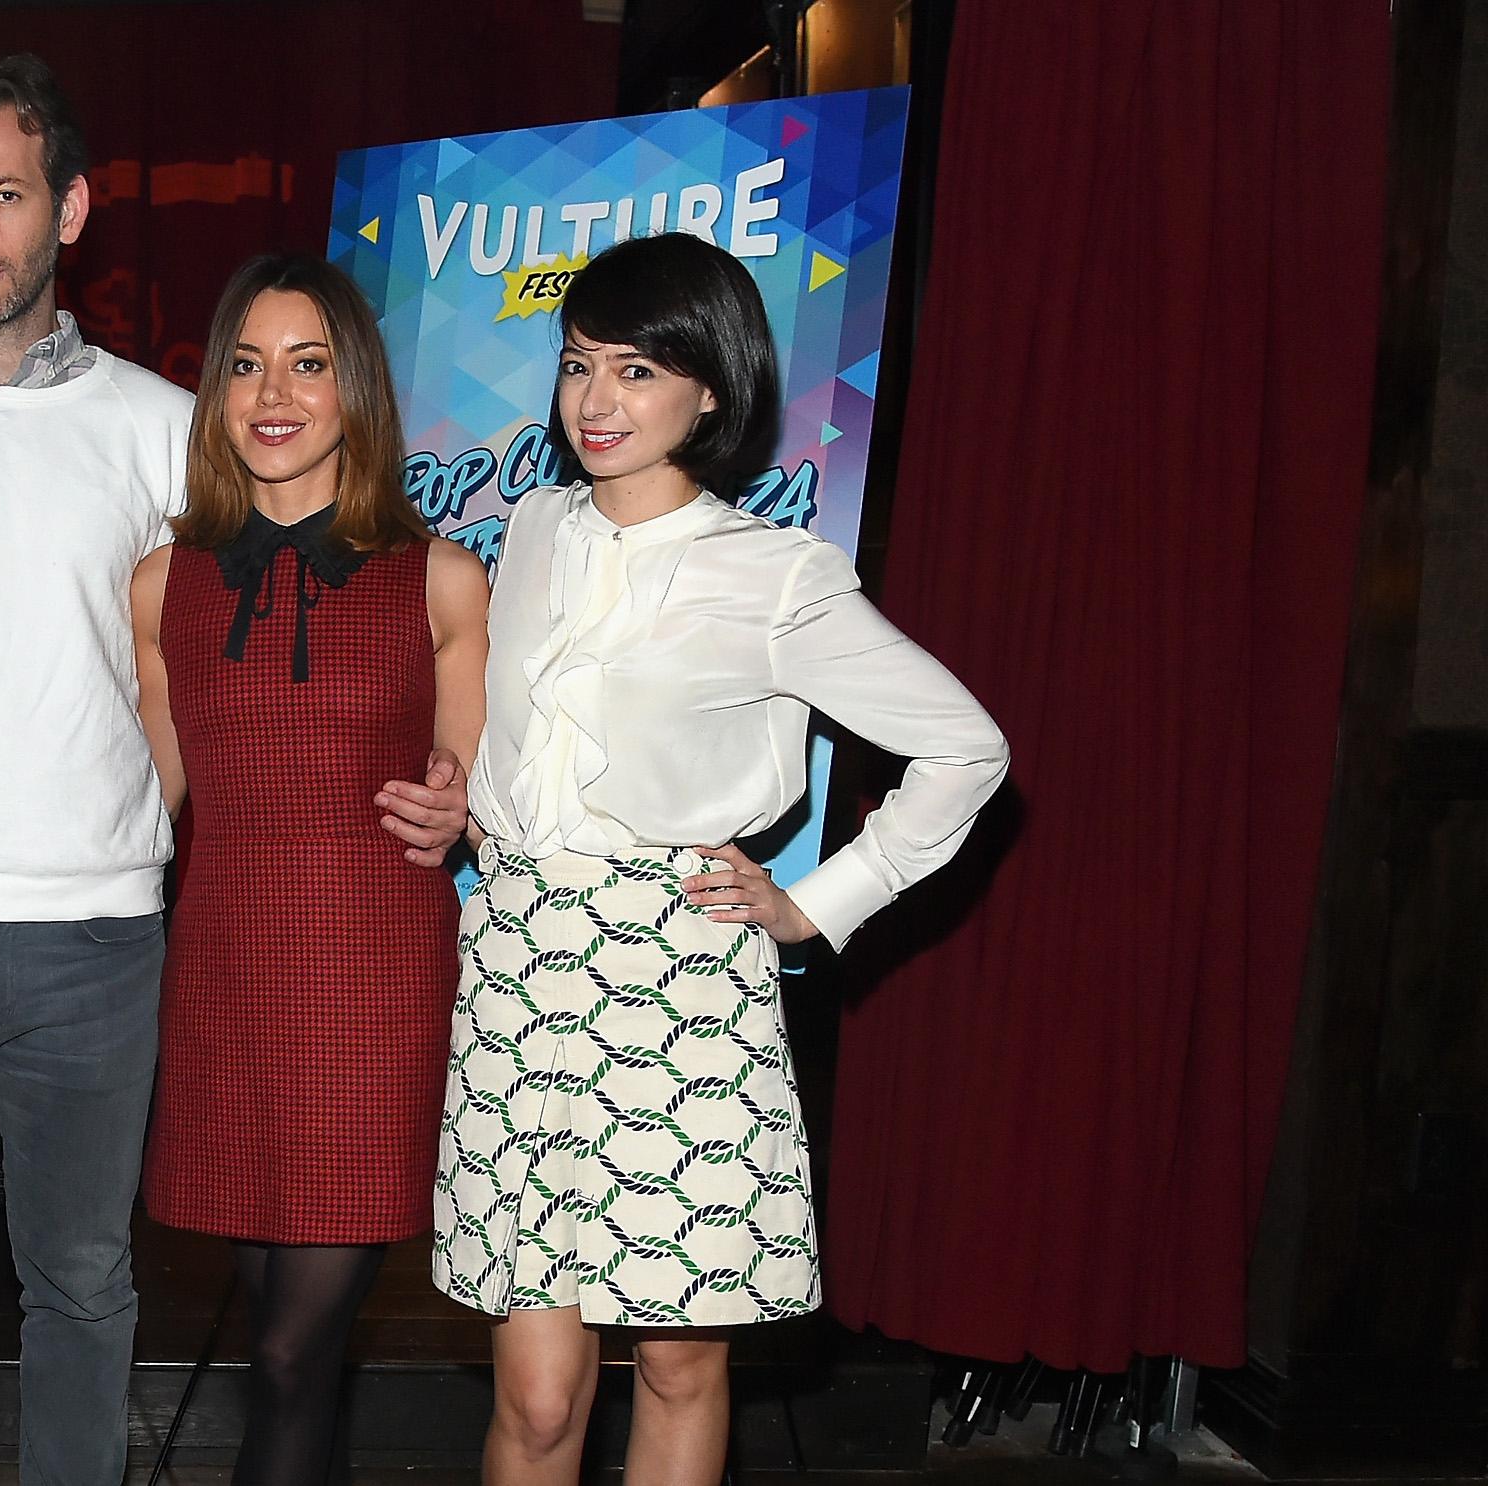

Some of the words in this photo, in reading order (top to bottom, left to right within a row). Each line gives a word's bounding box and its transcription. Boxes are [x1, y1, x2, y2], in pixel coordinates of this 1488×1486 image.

[417, 157, 785, 280] VULTURE
[518, 270, 576, 300] FES
[402, 450, 498, 524] POP
